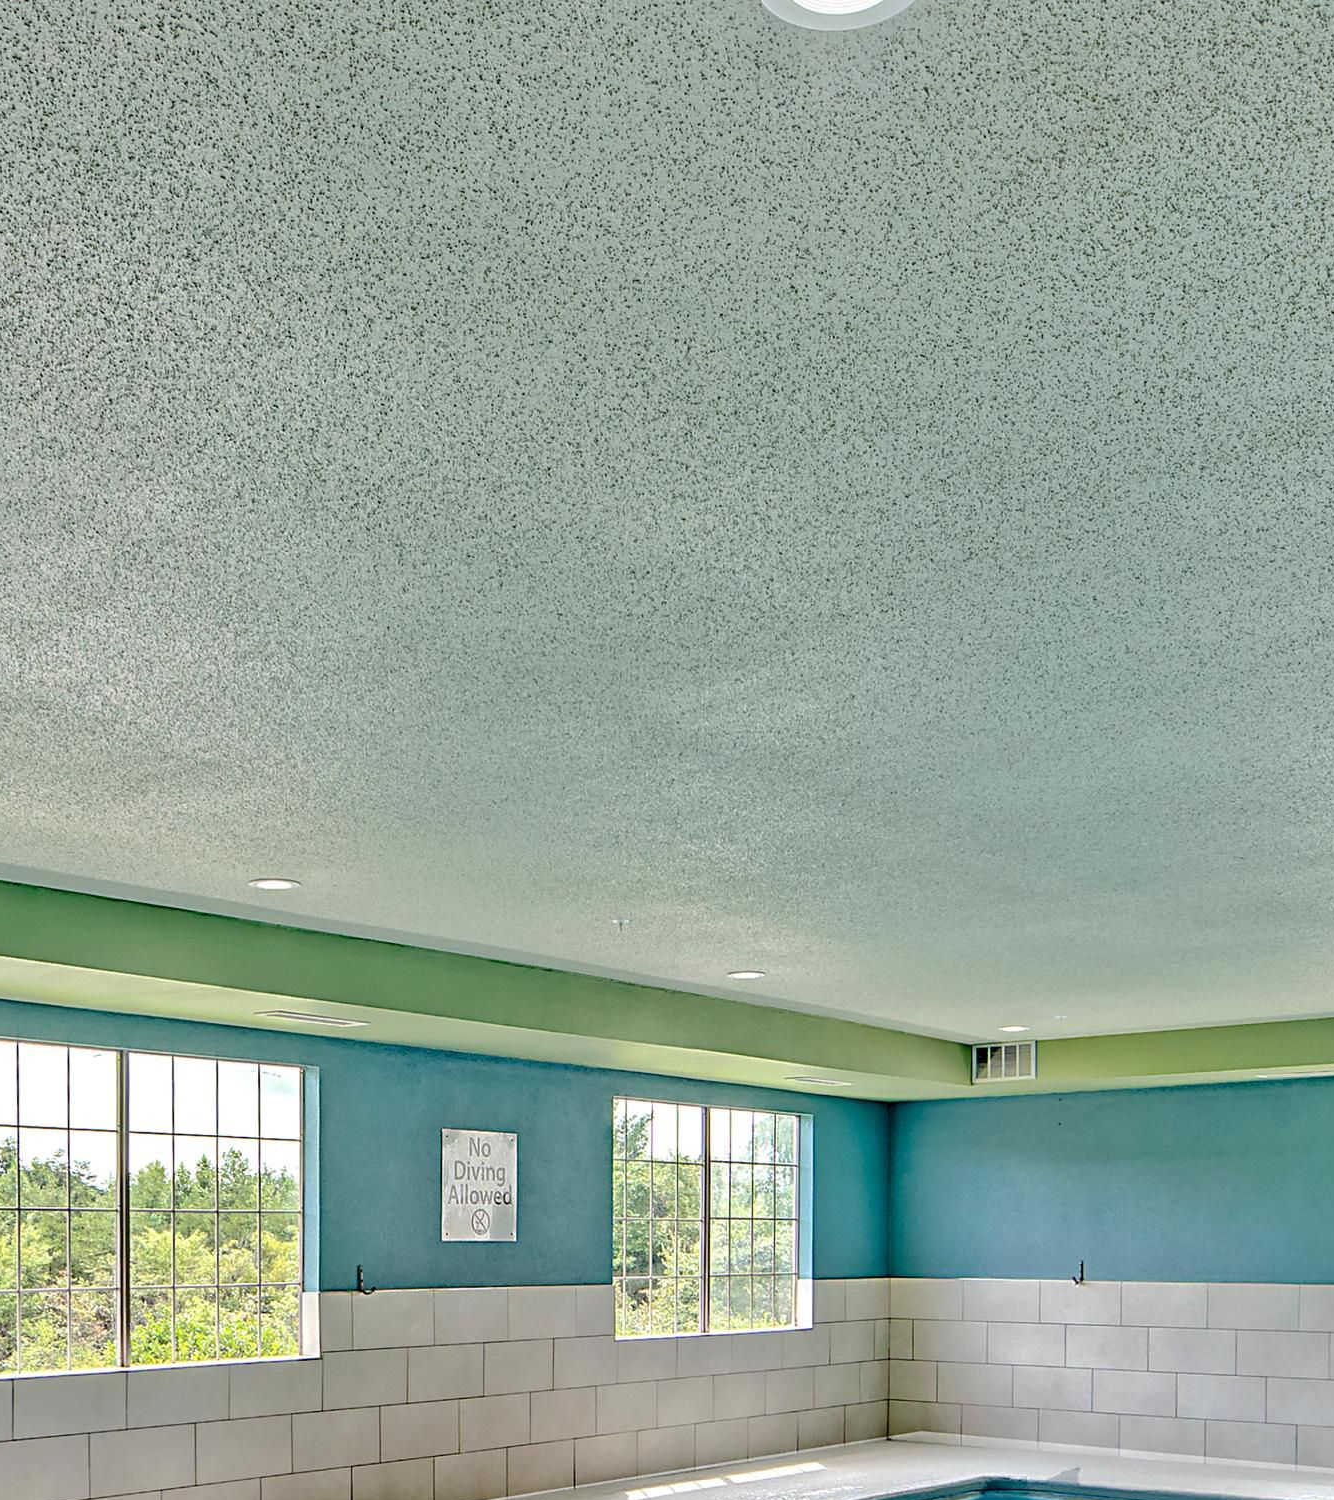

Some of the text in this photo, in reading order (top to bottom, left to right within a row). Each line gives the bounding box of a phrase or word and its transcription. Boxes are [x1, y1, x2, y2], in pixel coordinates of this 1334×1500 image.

[468, 1137, 491, 1158] No
[454, 1160, 506, 1187] Diving
[448, 1183, 512, 1205] Allowed
